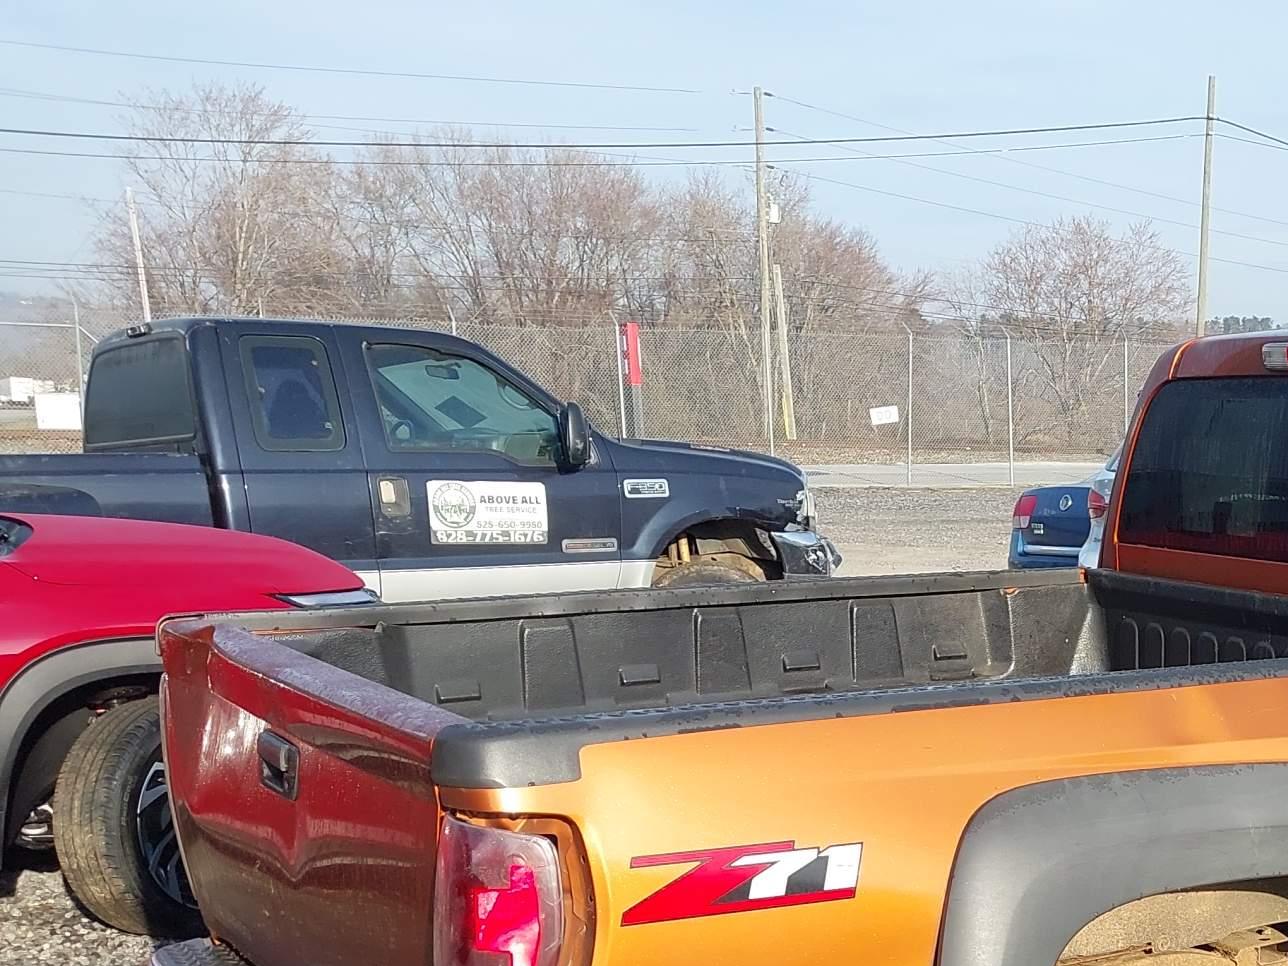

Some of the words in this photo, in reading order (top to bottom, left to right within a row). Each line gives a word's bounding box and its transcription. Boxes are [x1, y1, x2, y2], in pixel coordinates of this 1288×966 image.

[479, 495, 519, 505] ABOVE
[521, 495, 542, 505] ALL
[506, 506, 537, 514] SERVICE
[436, 530, 545, 543] 828-775-1676
[620, 839, 864, 907] Z71
